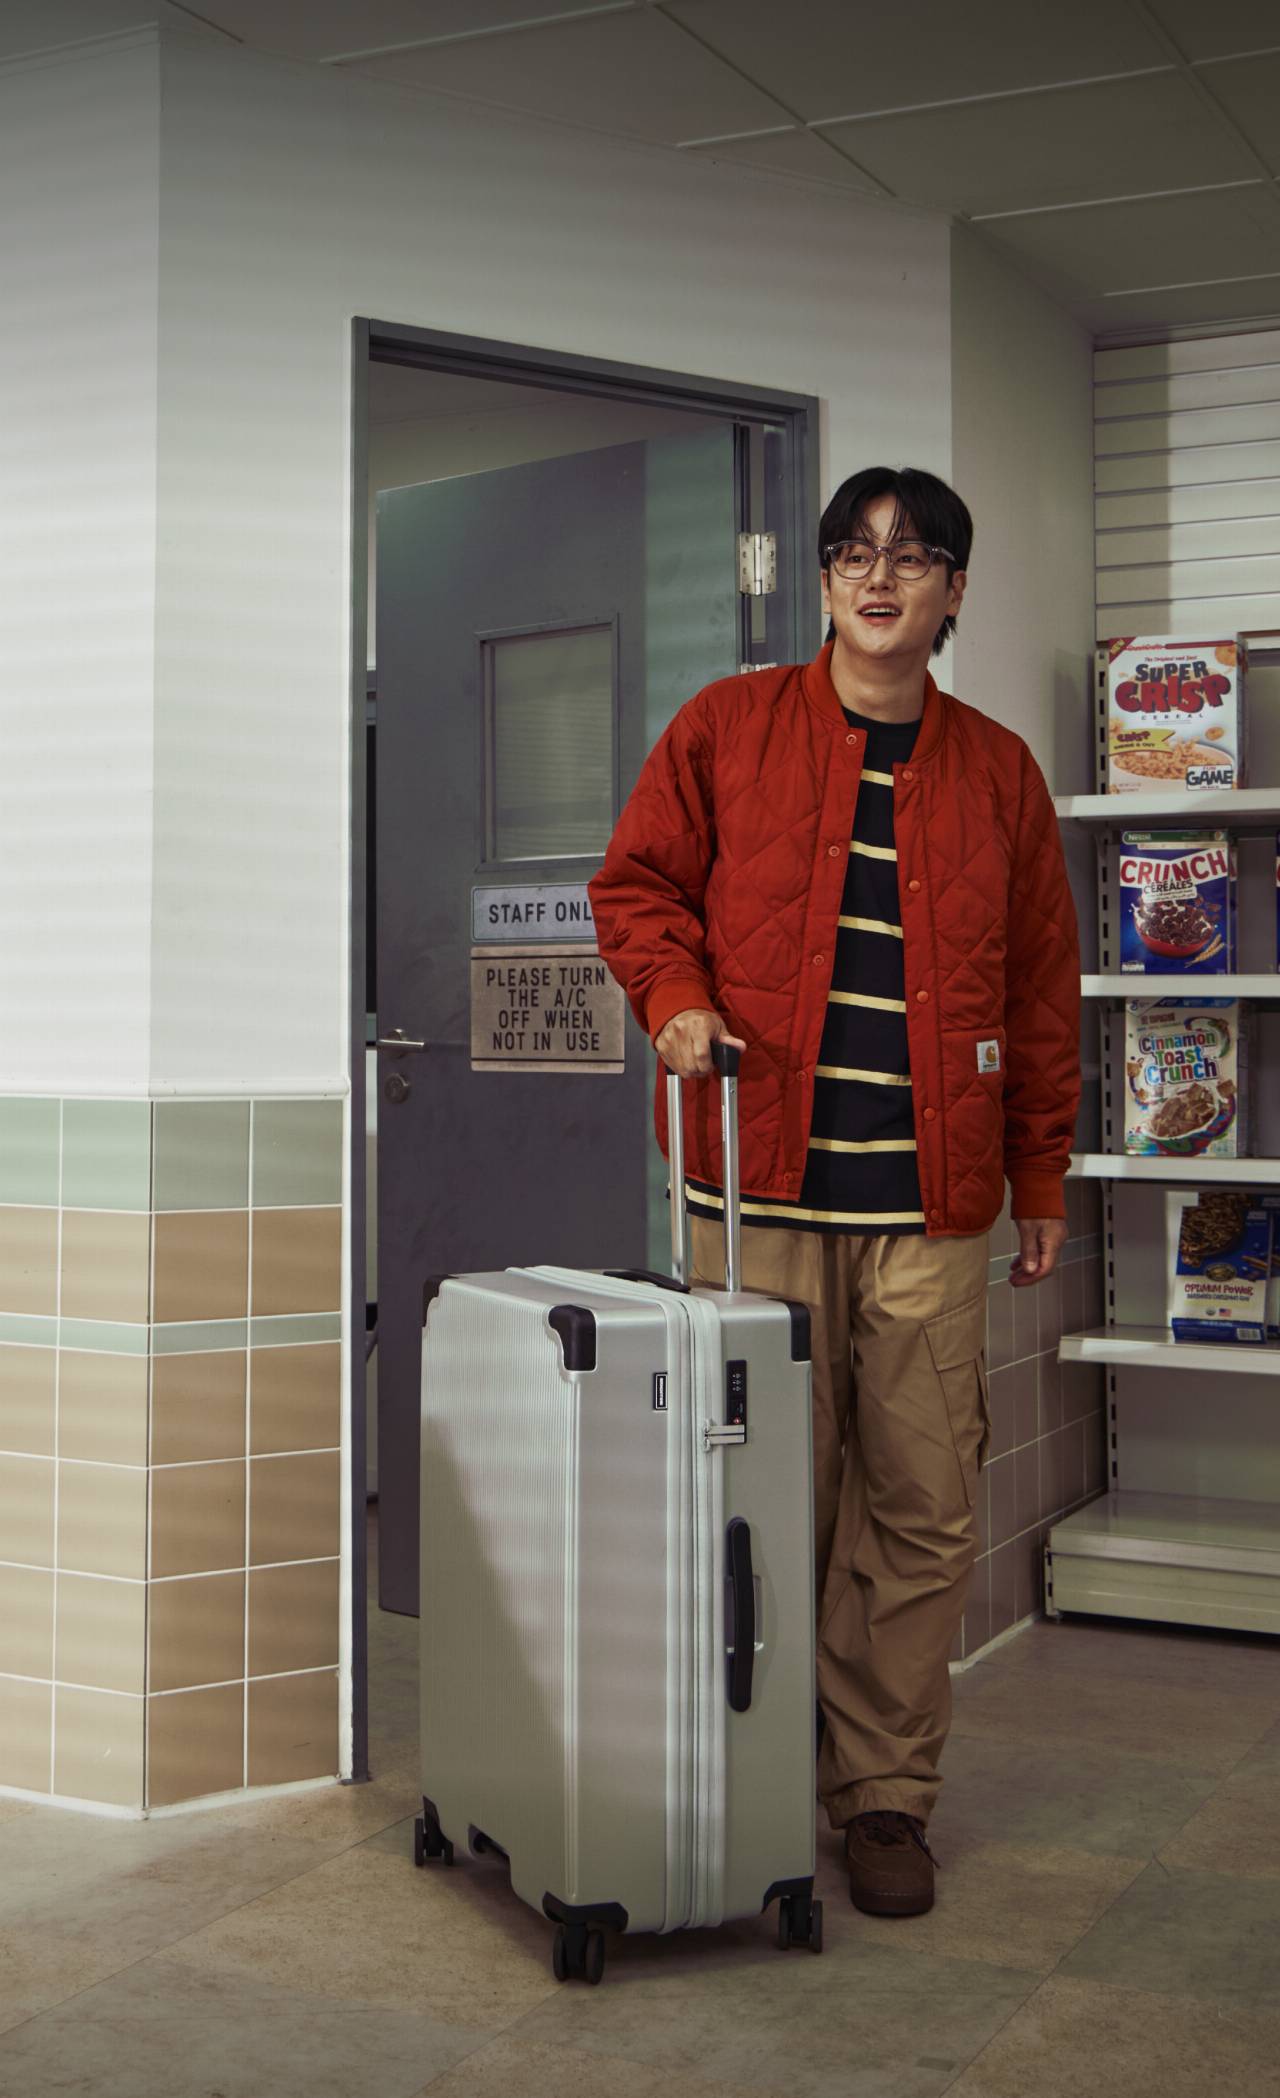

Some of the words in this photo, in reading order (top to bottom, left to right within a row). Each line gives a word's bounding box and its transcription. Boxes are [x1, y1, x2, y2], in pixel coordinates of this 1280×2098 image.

[1135, 661, 1209, 683] SUPER
[1115, 674, 1231, 713] CRISP
[1186, 770, 1233, 785] GAME
[1120, 850, 1227, 884] CRUNCH
[489, 903, 545, 924] STAFF
[555, 901, 592, 921] ONL
[487, 968, 550, 986] PLEASE
[560, 967, 605, 986] TURN
[508, 989, 539, 1007] THE
[554, 988, 586, 1009] A/C
[499, 1010, 530, 1029] OFF
[544, 1010, 592, 1029] WHEN
[493, 1032, 525, 1050] NOT
[533, 1032, 550, 1050] IN
[567, 1032, 600, 1051] USE
[1141, 1032, 1216, 1053] Cinnamon
[1155, 1046, 1202, 1066] Toast
[1146, 1058, 1217, 1084] Crunch
